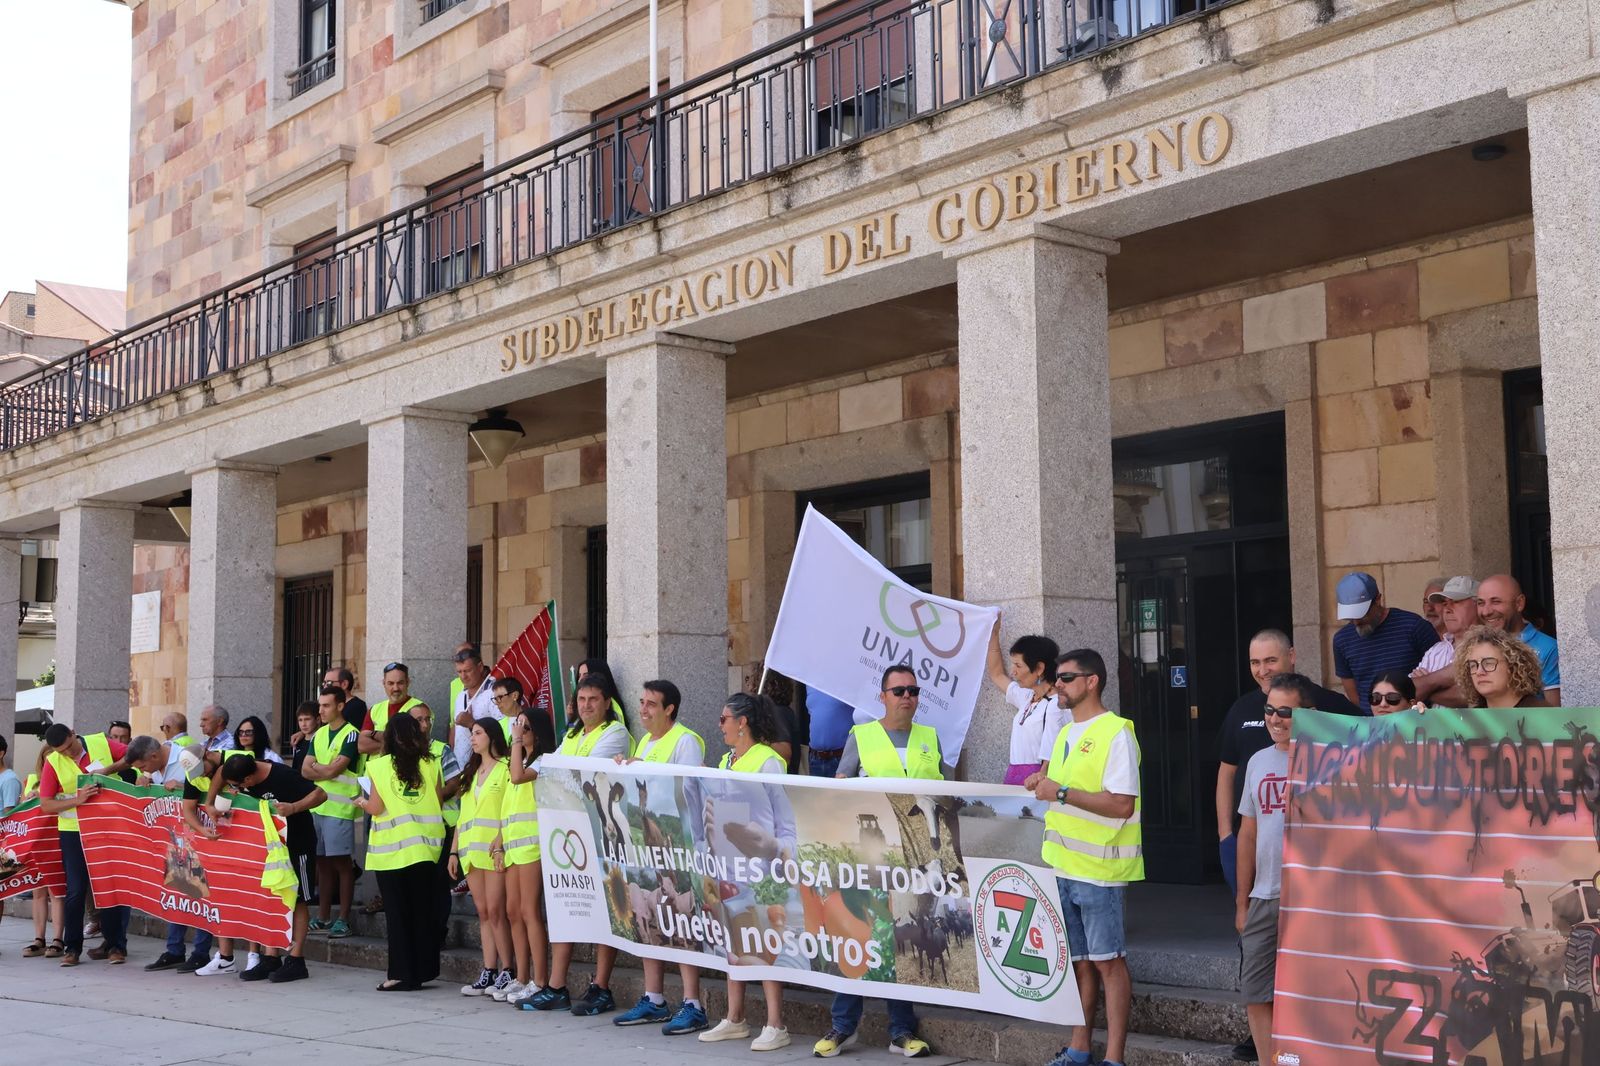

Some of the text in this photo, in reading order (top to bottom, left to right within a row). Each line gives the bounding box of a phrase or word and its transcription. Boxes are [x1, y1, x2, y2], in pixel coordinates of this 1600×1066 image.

[500, 112, 1233, 372] SUBDELEGACION DEL GOBIERNO
[861, 625, 960, 698] UNASPI
[549, 873, 595, 891] UNASPI
[600, 839, 964, 899] LA ALIMENTACIÓN ES COSA DE TODOS
[656, 895, 724, 947] Únete
[741, 926, 882, 970] nosotros
[996, 911, 1010, 933] A
[1029, 927, 1044, 950] G
[1057, 940, 1067, 971] LIBRES
[1016, 985, 1042, 998] ZAMORA
